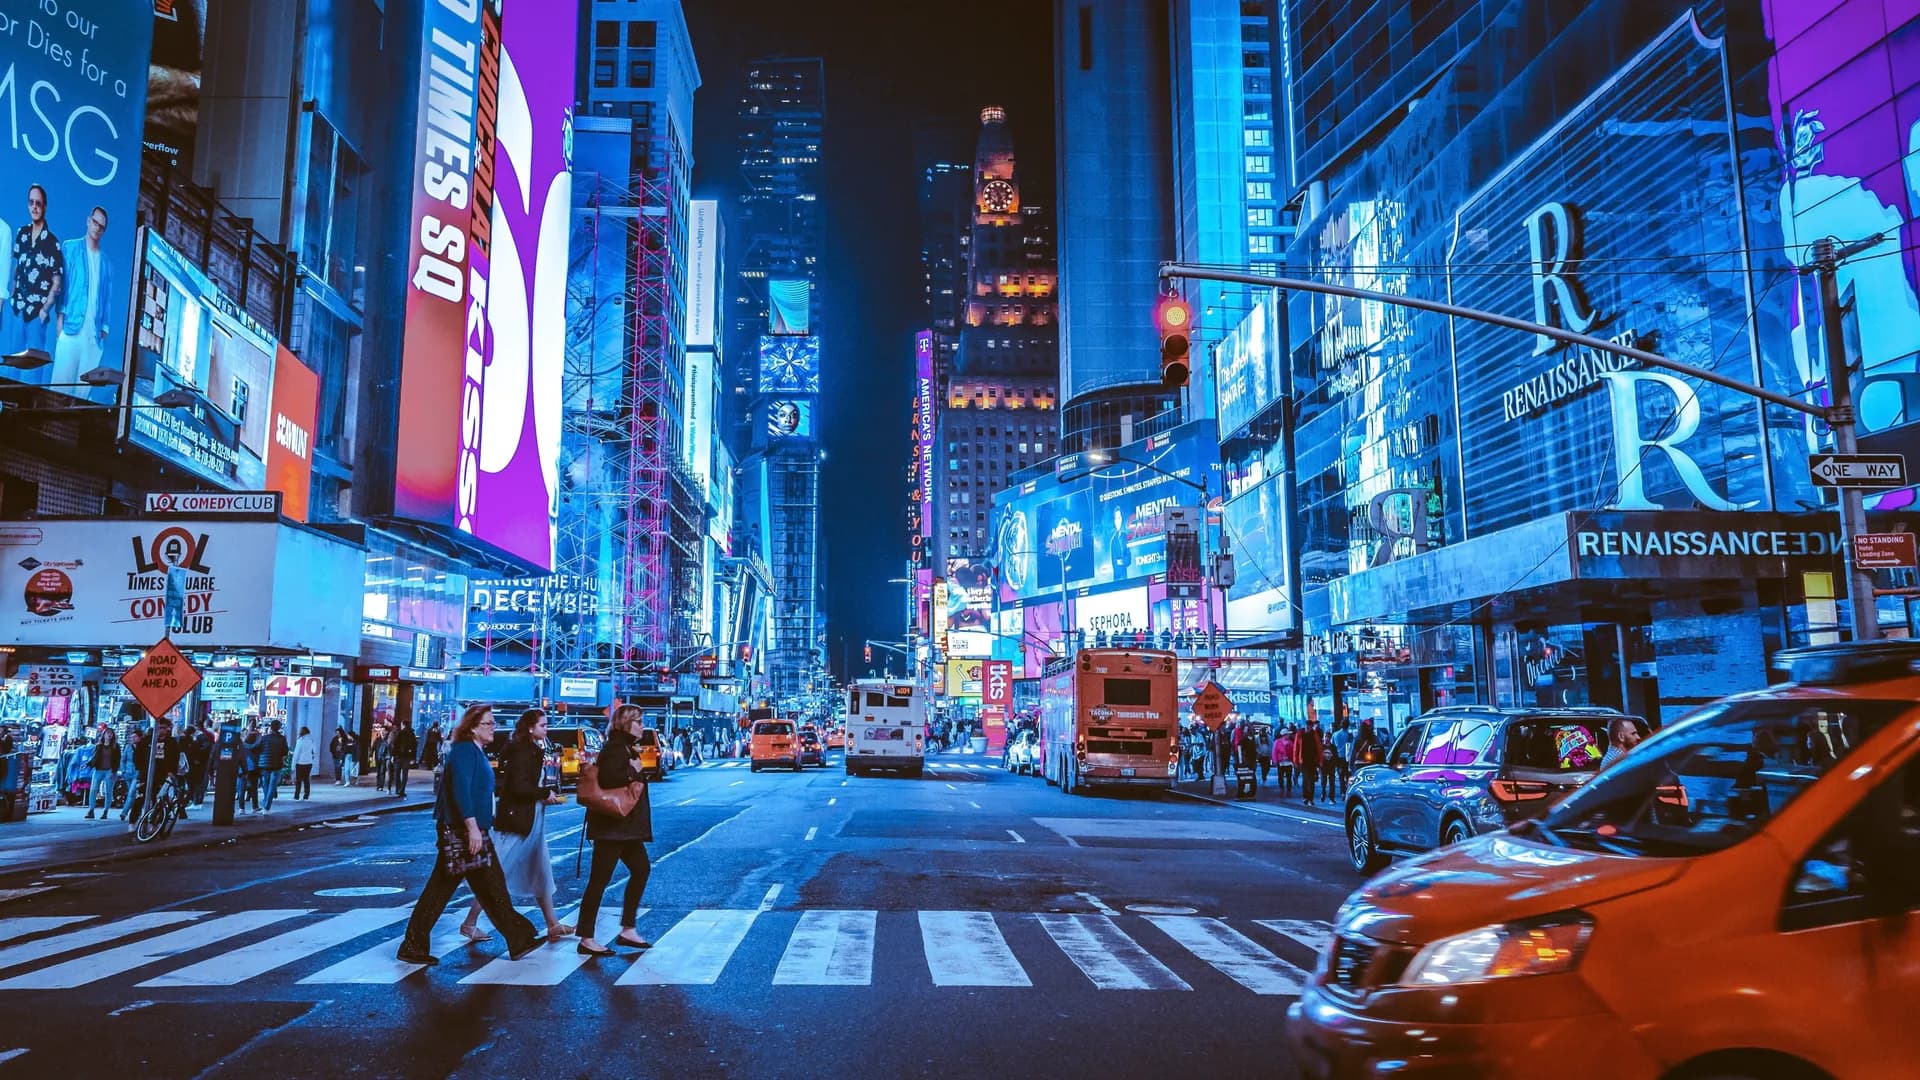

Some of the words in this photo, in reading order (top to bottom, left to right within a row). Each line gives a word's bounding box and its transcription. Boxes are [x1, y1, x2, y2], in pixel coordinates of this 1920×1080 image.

[66, 10, 99, 40] our
[28, 19, 72, 67] Dies
[81, 48, 108, 86] for
[115, 79, 126, 98] a
[424, 28, 475, 210] TIMES
[412, 215, 466, 303] SQ
[1522, 202, 1597, 358] R
[1503, 329, 1640, 423] RENAISSANCE
[921, 377, 931, 441] AMERICA'S
[1599, 371, 1761, 511] R
[923, 445, 932, 505] NETWORK
[1822, 464, 1852, 477] ONE
[1866, 464, 1897, 477] WAY
[150, 493, 177, 512] LOL
[1135, 495, 1180, 519] MENTAL
[1051, 521, 1082, 539] MENTAL
[1857, 537, 1868, 545] NO
[1870, 535, 1905, 544] STANDING
[132, 526, 210, 574] LOL
[1578, 531, 1790, 557] RENAISSANCE
[185, 576, 216, 590] UARE
[130, 593, 213, 619] COMDY
[473, 589, 600, 616] DECEMBER
[1090, 612, 1132, 631] SEPHORA
[147, 666, 174, 676] WORK
[149, 655, 177, 665] ROAD
[141, 678, 178, 688] AHEAD
[990, 664, 1008, 700] tkts
[225, 732, 233, 741] P
